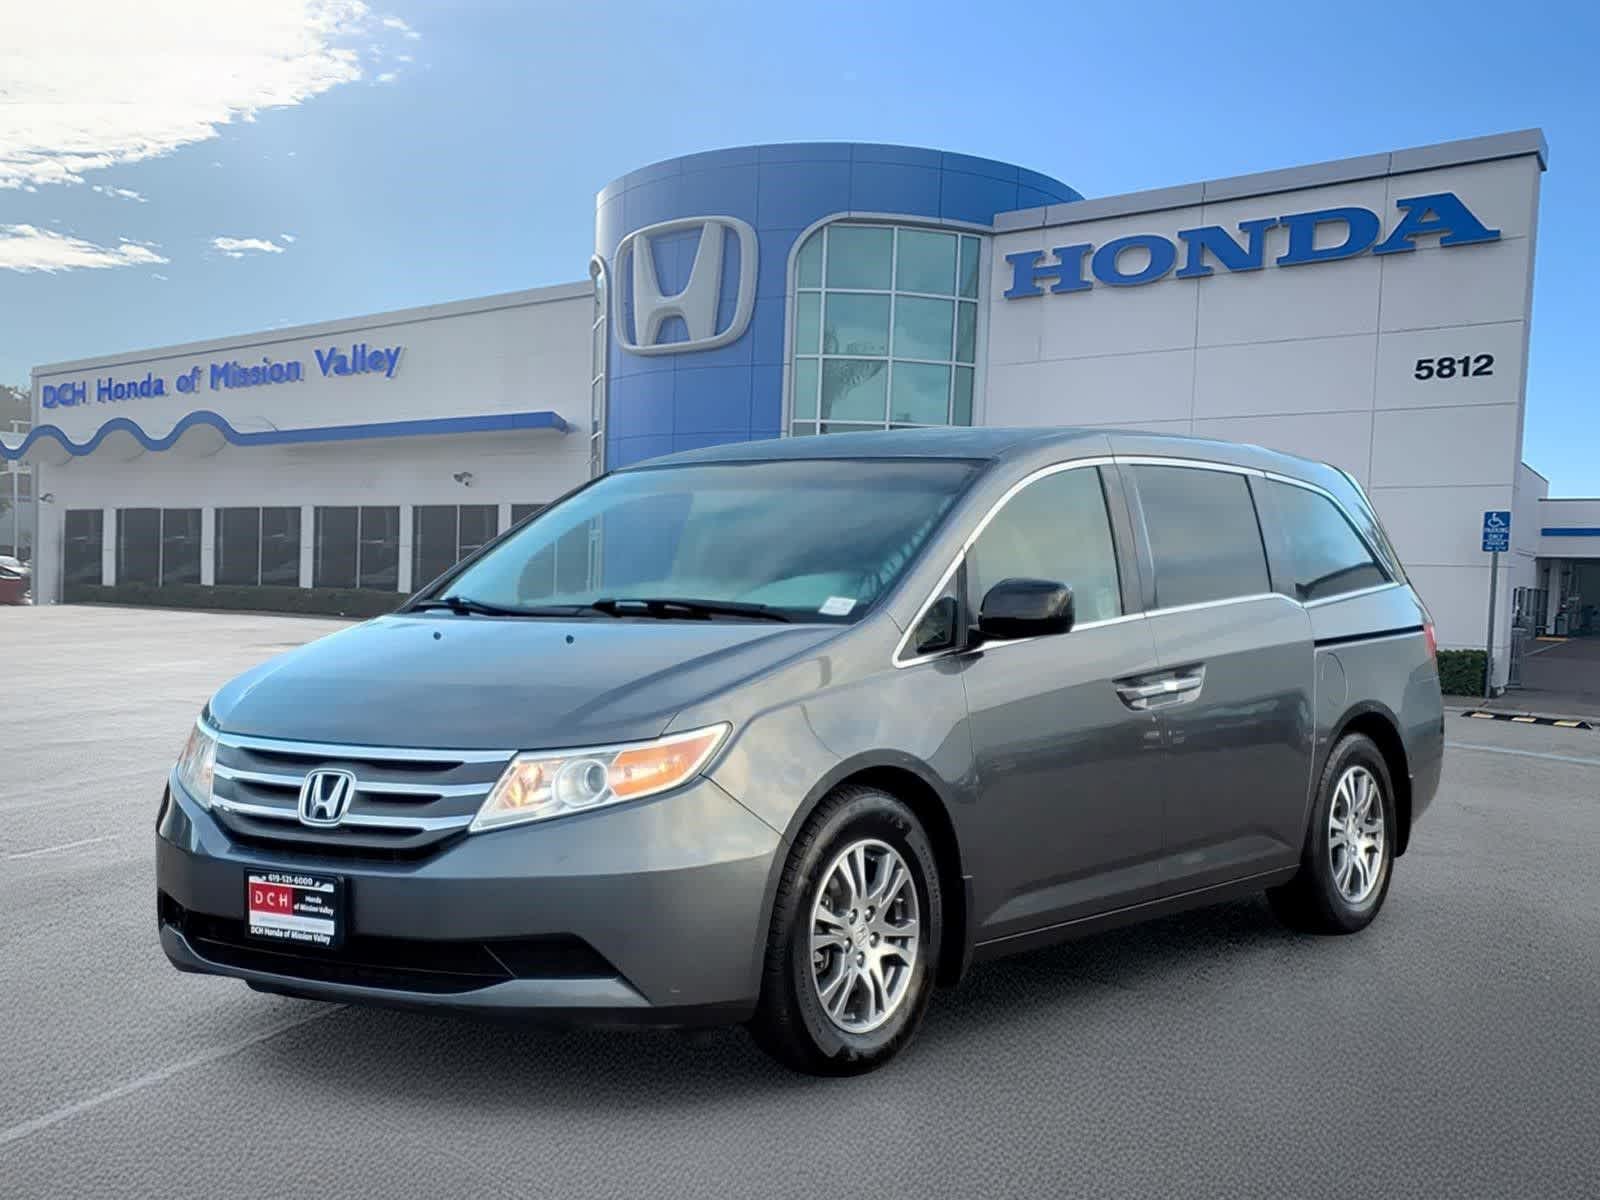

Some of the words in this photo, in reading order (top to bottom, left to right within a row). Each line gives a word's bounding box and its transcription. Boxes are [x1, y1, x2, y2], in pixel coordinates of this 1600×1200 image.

[1004, 192, 1501, 299] HONDA
[42, 380, 87, 409] DCH
[96, 372, 165, 403] Honda
[175, 366, 203, 393] of
[210, 357, 303, 390] Mission
[314, 344, 402, 378] Valley
[1414, 354, 1495, 380] 5812
[268, 874, 313, 885] 619-521-6000
[255, 891, 288, 907] DCH
[250, 926, 264, 934] DCH
[264, 928, 283, 937] Honda
[284, 930, 290, 938] of
[291, 931, 313, 941] Mission
[313, 934, 331, 946] Valley
